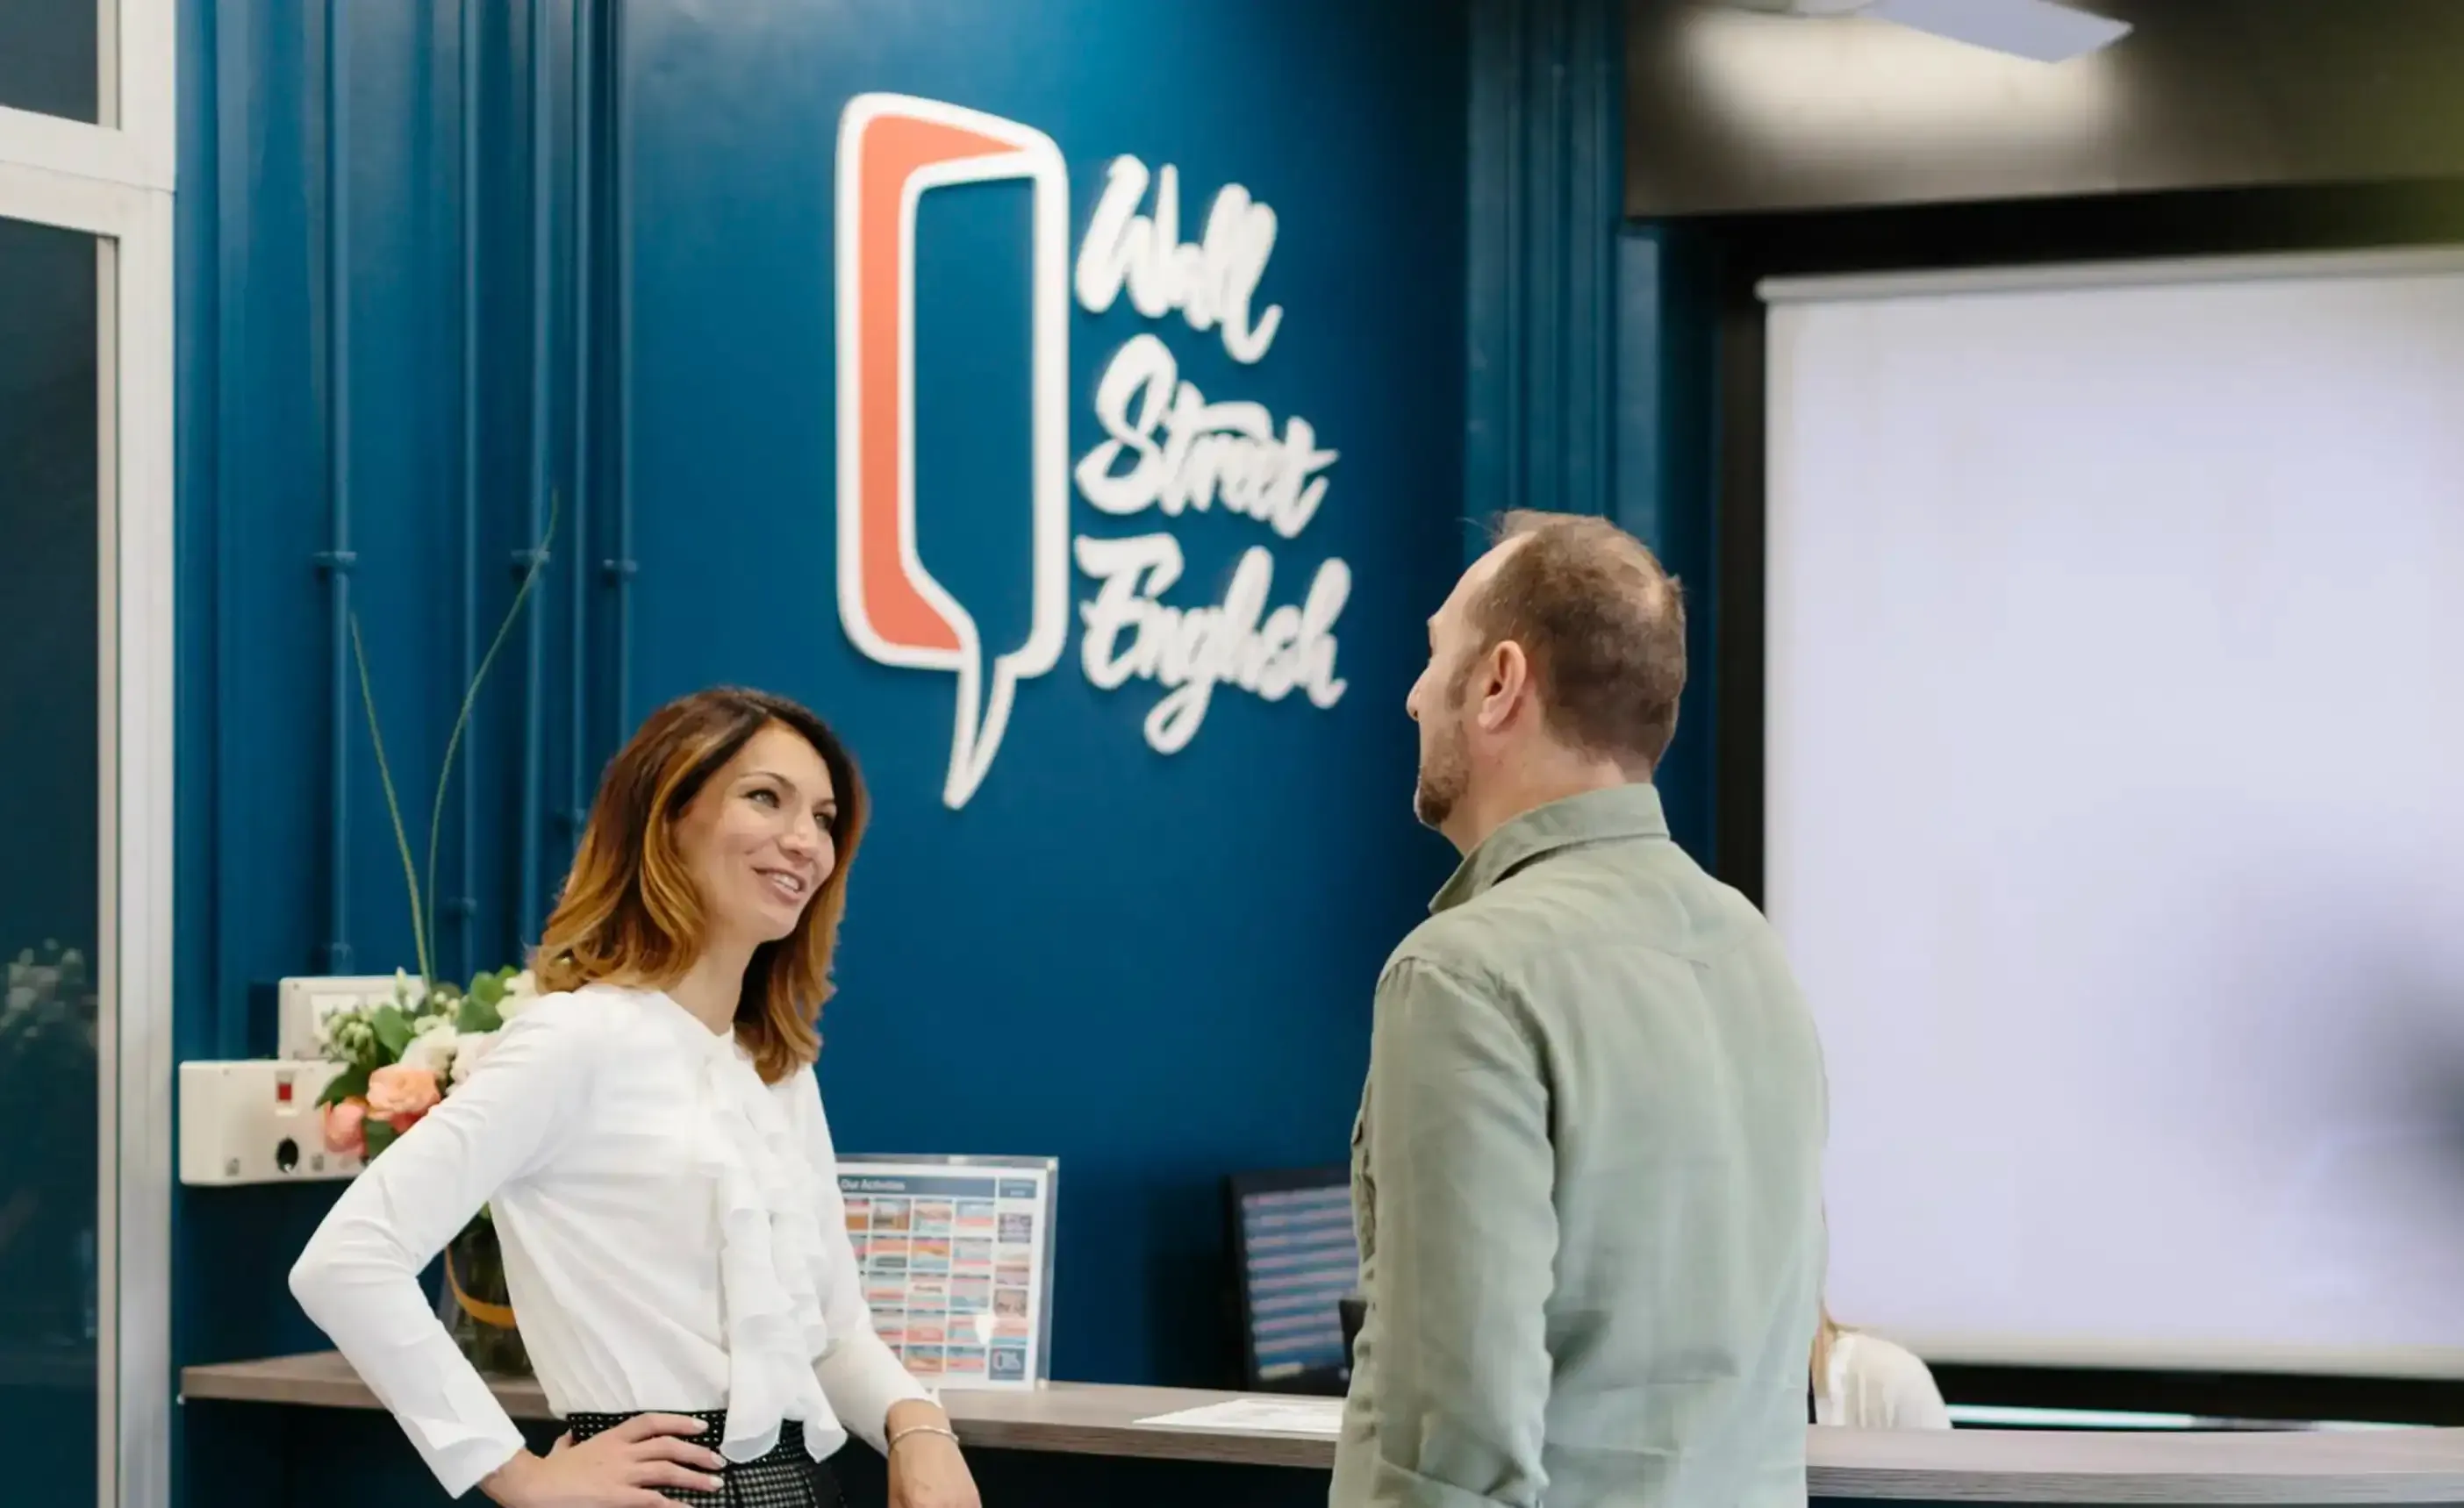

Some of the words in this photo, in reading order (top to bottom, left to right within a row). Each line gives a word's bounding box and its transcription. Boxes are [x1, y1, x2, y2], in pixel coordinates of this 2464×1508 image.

[1075, 154, 1282, 363] Wall
[1075, 333, 1338, 538] Street
[1075, 532, 1351, 753] English
